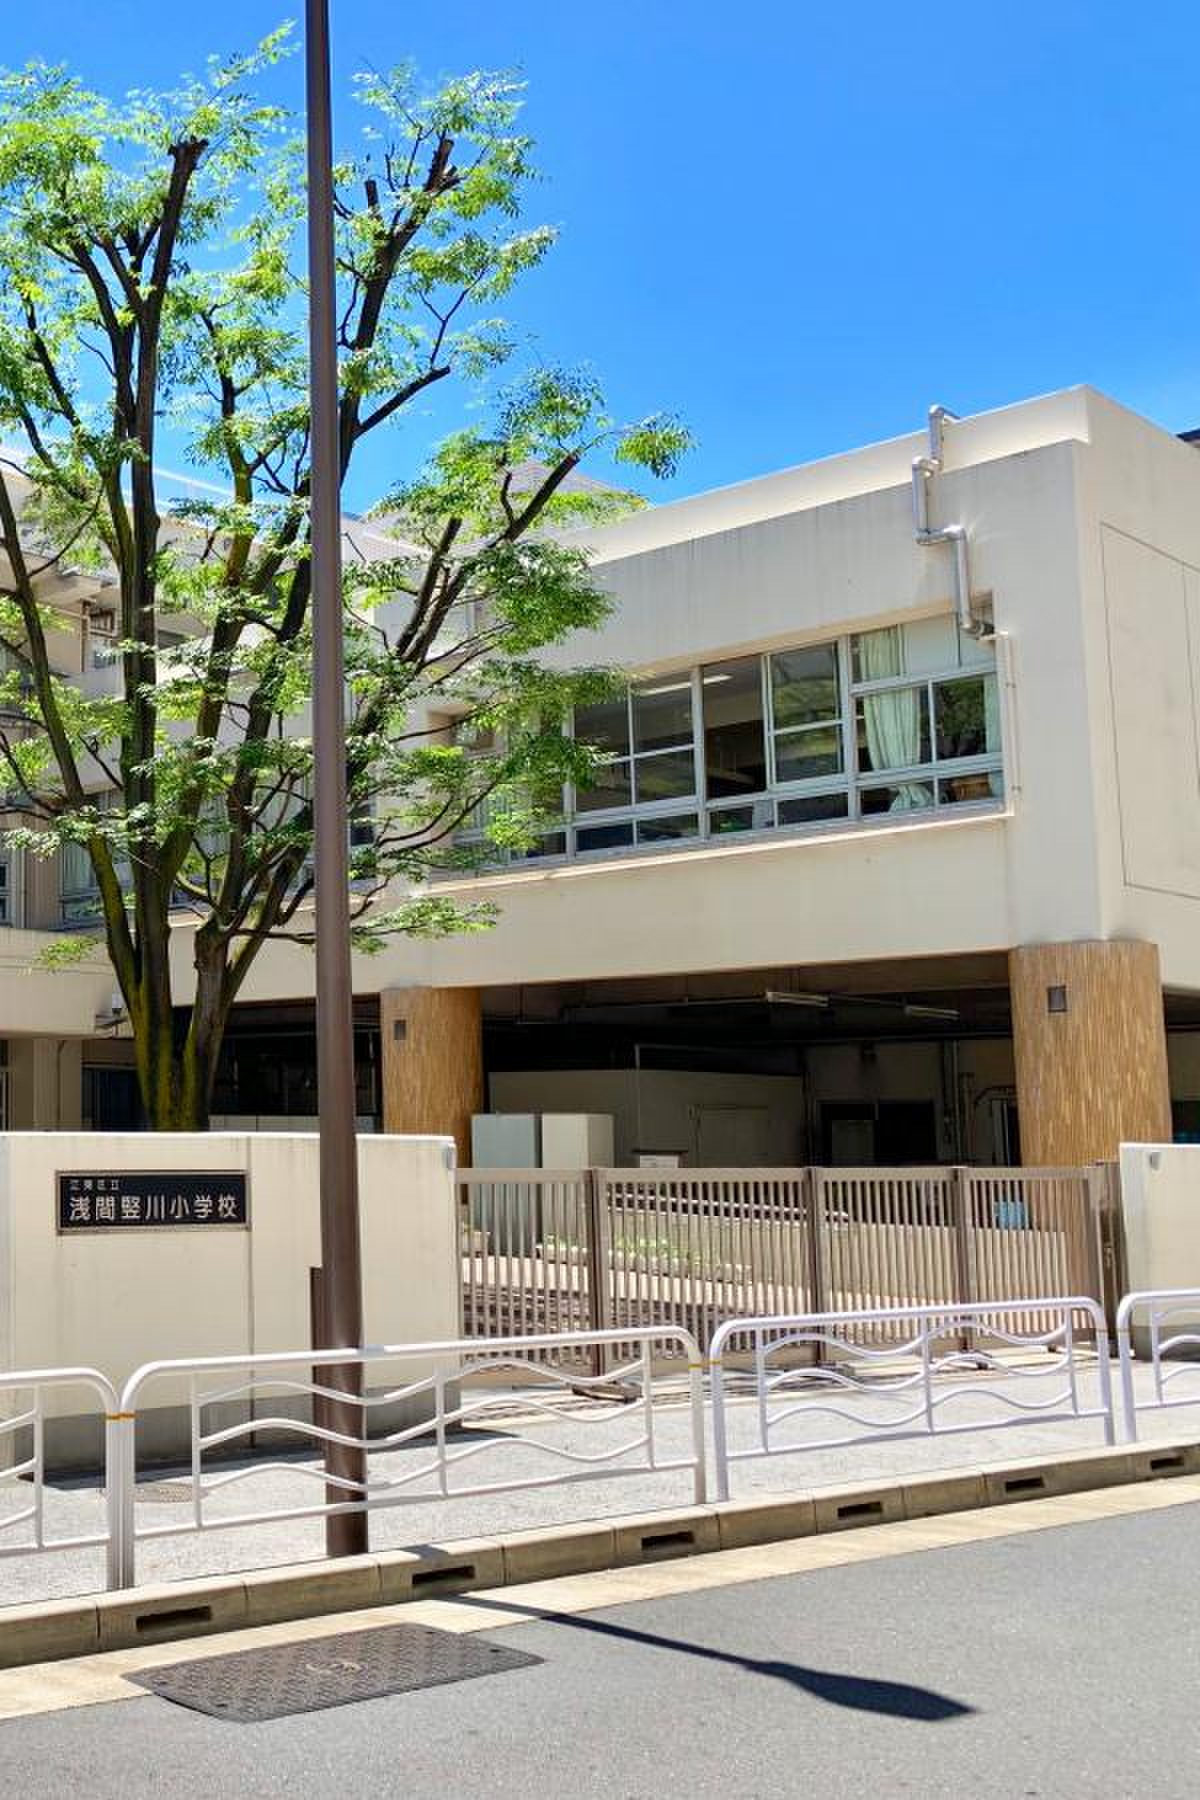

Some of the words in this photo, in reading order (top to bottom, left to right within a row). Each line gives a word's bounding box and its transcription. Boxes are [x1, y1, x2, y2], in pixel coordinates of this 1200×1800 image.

[68, 1195, 238, 1221] 浅間竪川小学校
